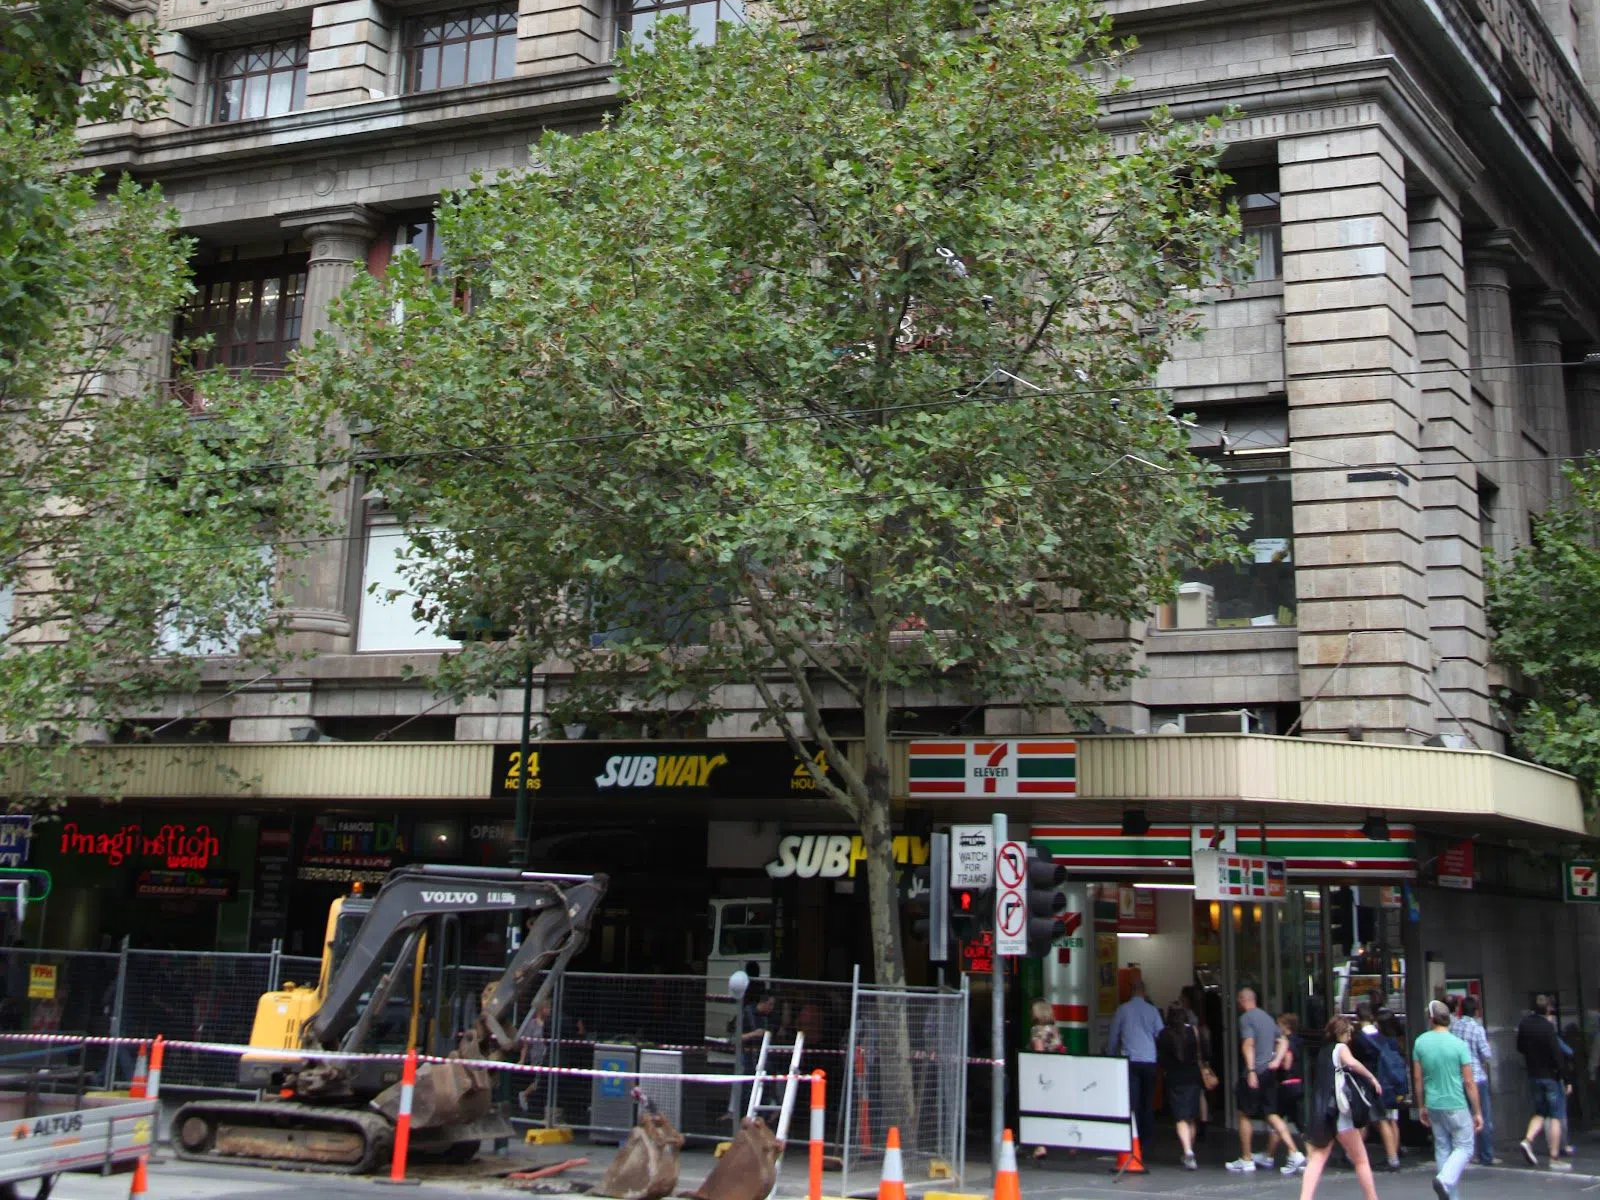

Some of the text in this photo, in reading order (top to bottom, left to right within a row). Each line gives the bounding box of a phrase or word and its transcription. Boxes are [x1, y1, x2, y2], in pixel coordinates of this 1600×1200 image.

[508, 751, 540, 777] 24
[595, 753, 728, 788] SUBWAY
[974, 743, 1008, 792] 7
[505, 778, 541, 789] HORS
[959, 852, 988, 864] WATCH
[964, 864, 980, 873] FOR
[957, 873, 987, 885] TRAMS
[420, 891, 479, 904] VOLVO
[33, 1113, 83, 1136] ALTUS
